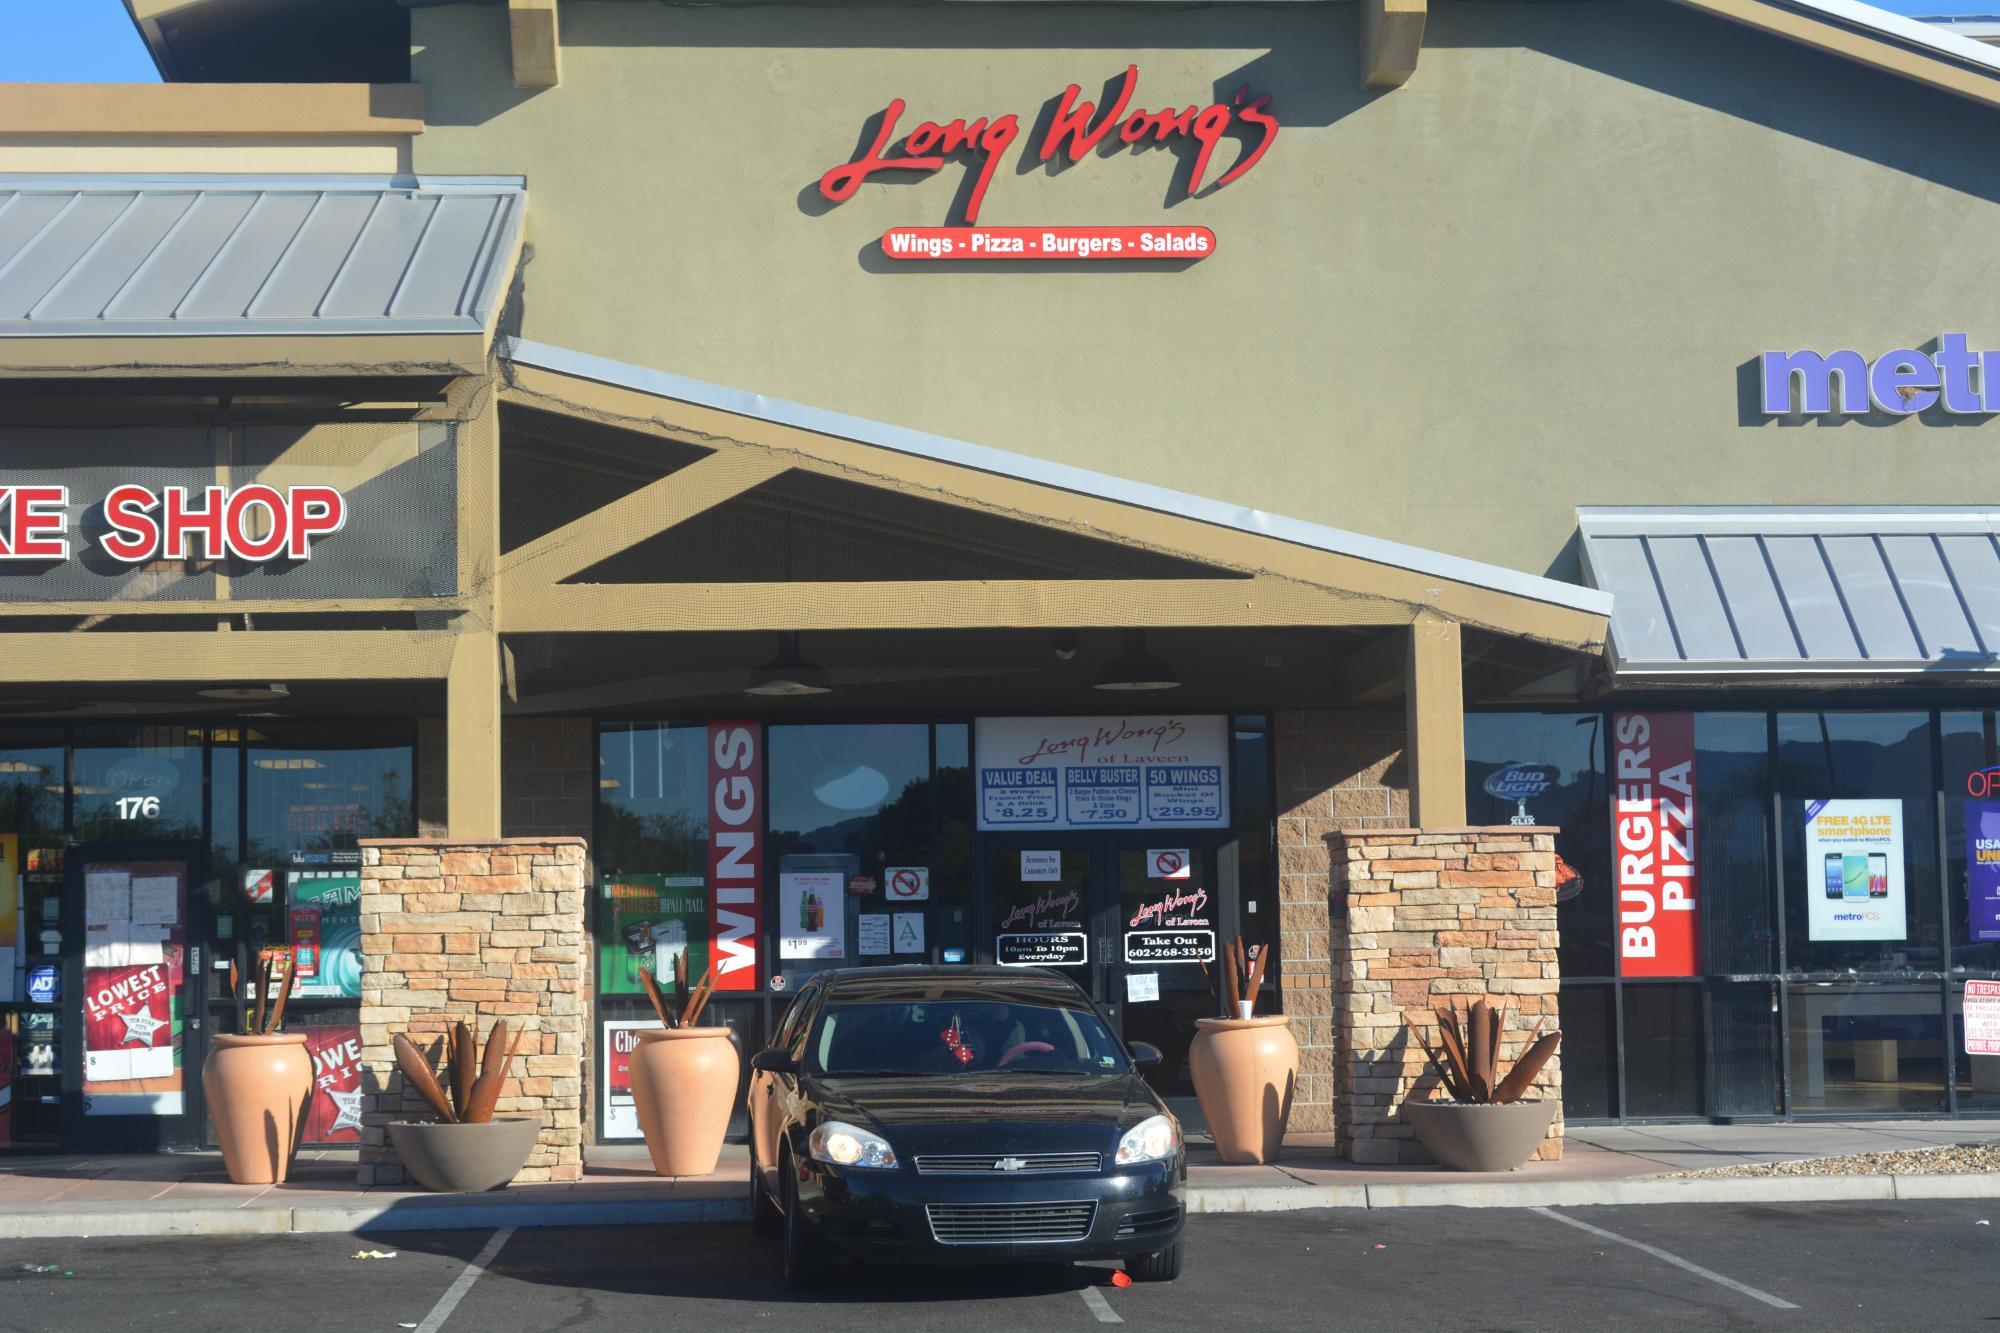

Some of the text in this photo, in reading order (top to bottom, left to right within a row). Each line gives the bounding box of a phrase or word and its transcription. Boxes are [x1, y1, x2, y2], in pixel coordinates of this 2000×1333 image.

[820, 63, 1279, 226] Long Wong's
[890, 233, 953, 257] Wings
[971, 233, 1025, 253] Pizza
[1041, 233, 1123, 257] Burgers
[1139, 232, 1209, 252] Salads
[99, 484, 347, 562] SHOP
[1018, 720, 1186, 765] Long Wong's
[1097, 754, 1190, 764] of Laveen
[985, 769, 1055, 785] VALUE DEAL
[1068, 768, 1138, 784] BELLY BUSTER
[1150, 769, 1218, 784] 50 WINGS
[1505, 770, 1545, 781] BUD
[1496, 782, 1550, 792] LIGHT
[115, 796, 161, 820] 176
[1510, 817, 1536, 825] XLIX
[1816, 815, 1892, 826] FREE 4G LTE
[1617, 713, 1656, 959] BURGERS
[1659, 759, 1696, 911] PIZZA
[1818, 826, 1892, 838] smartphone
[714, 727, 756, 974] WINGS
[611, 884, 657, 897] MENTHOL
[667, 898, 684, 913] PALL
[685, 898, 704, 913] MALL
[1129, 901, 1164, 927] Long
[1164, 887, 1208, 918] Wong's
[321, 916, 357, 925] MENT
[1001, 904, 1036, 929] Long
[1165, 917, 1176, 926] of
[1177, 917, 1210, 926] Laveen
[899, 919, 918, 941] A
[1016, 935, 1069, 943] HOURS
[1141, 936, 1198, 946] Take Out
[1050, 945, 1079, 953] 10pm
[1128, 947, 1212, 958] 602-268-3350
[1018, 953, 1066, 962] Everyday
[31, 974, 58, 992] ADT
[86, 964, 161, 1013] LOWEST
[1967, 983, 1976, 995] NO
[94, 981, 167, 1021] PRICE
[1967, 1039, 1987, 1051] PRIVATE
